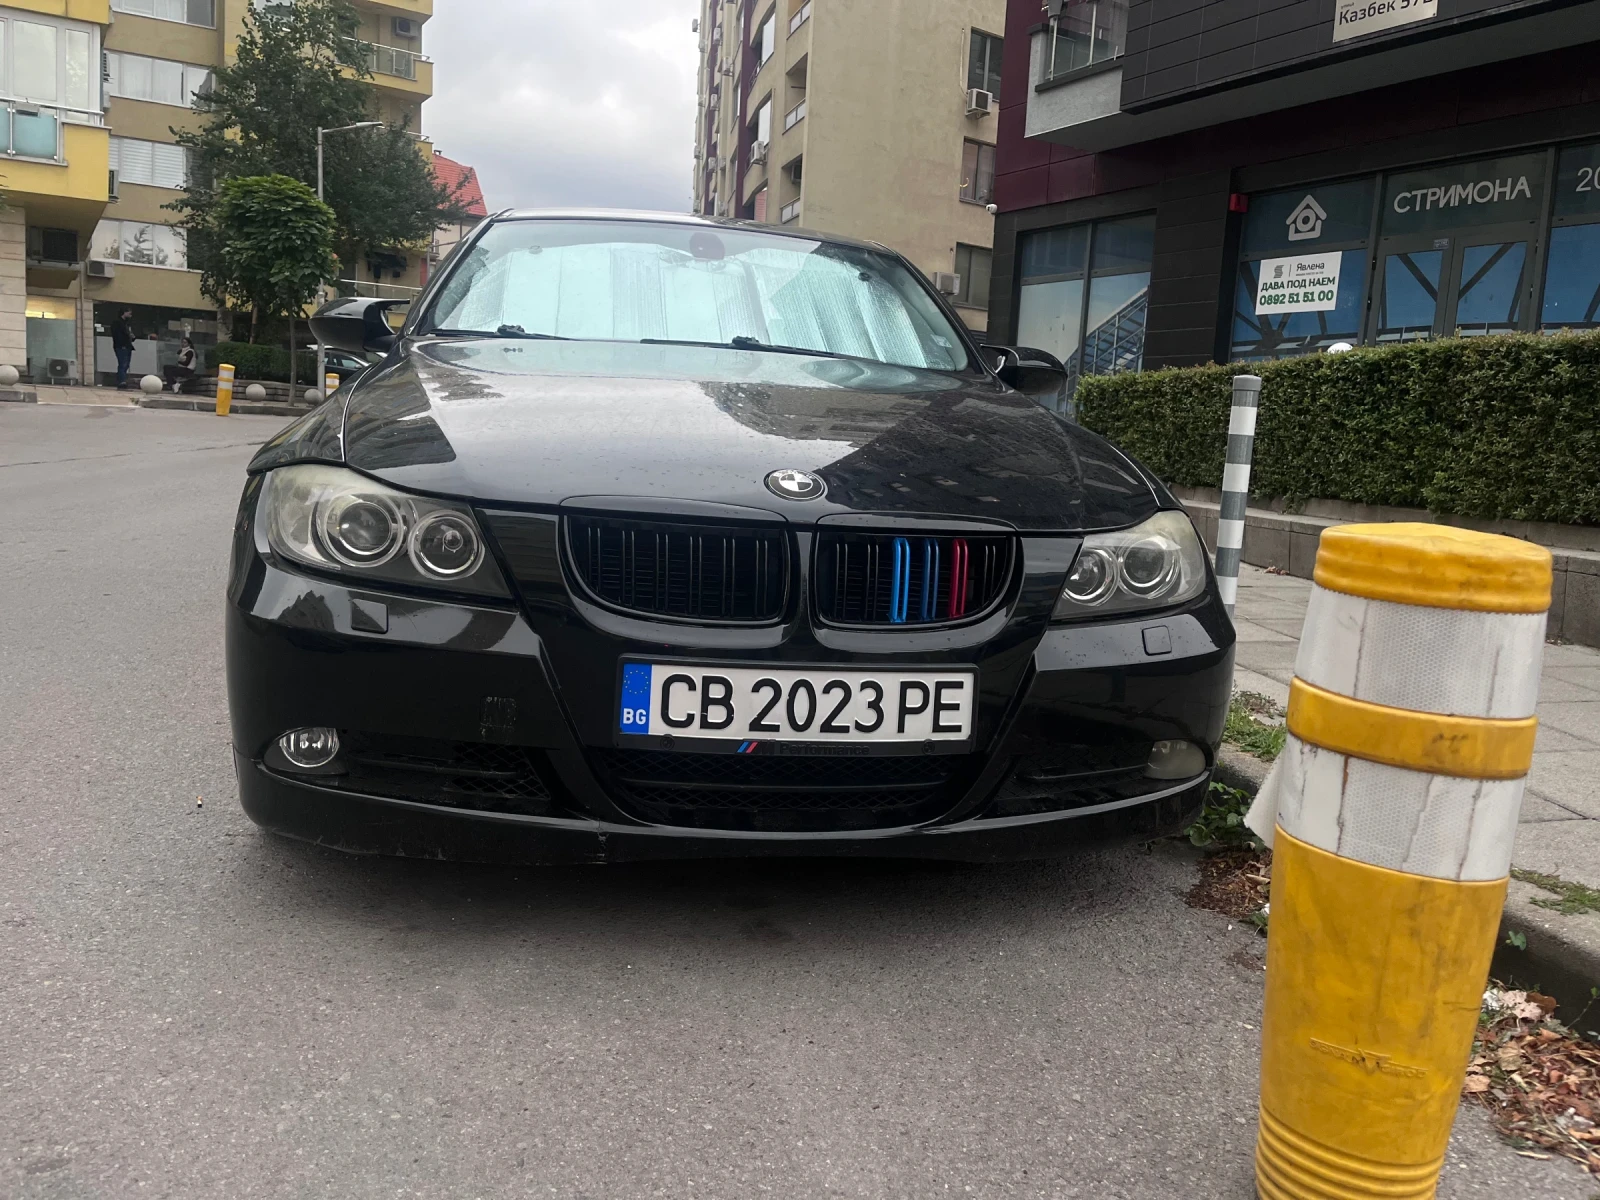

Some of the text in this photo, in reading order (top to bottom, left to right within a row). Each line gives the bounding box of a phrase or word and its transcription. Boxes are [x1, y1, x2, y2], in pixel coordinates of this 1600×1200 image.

[1339, 1, 1395, 25] Казбек
[1394, 176, 1531, 213] СТРИМОНА
[1296, 263, 1325, 271] Явлена
[1261, 277, 1336, 292] ДАВА ПОД НАЕМ
[1260, 290, 1334, 306] 0892 51 51 00
[661, 674, 964, 733] CB 2023 PE
[623, 708, 646, 725] BG
[779, 742, 870, 756] Performance
